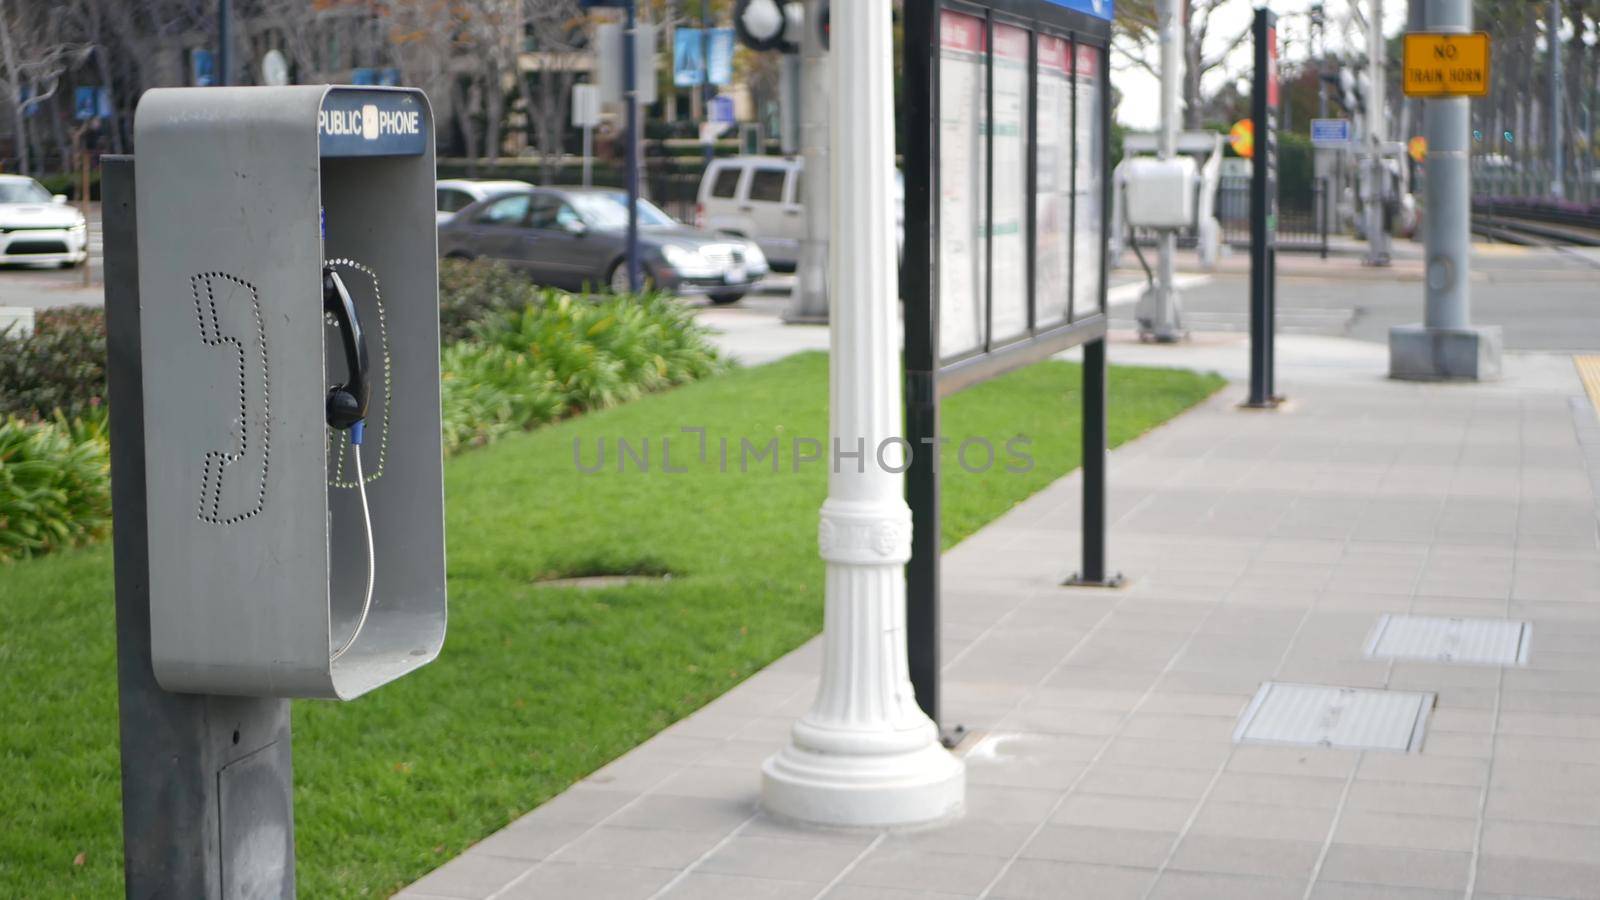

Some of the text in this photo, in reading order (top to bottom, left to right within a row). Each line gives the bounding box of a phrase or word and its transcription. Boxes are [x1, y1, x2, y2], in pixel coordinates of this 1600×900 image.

[1433, 44, 1456, 58] NO
[1408, 68, 1481, 82] TRAIN HORN
[318, 110, 419, 135] PUBLIC PHONE
